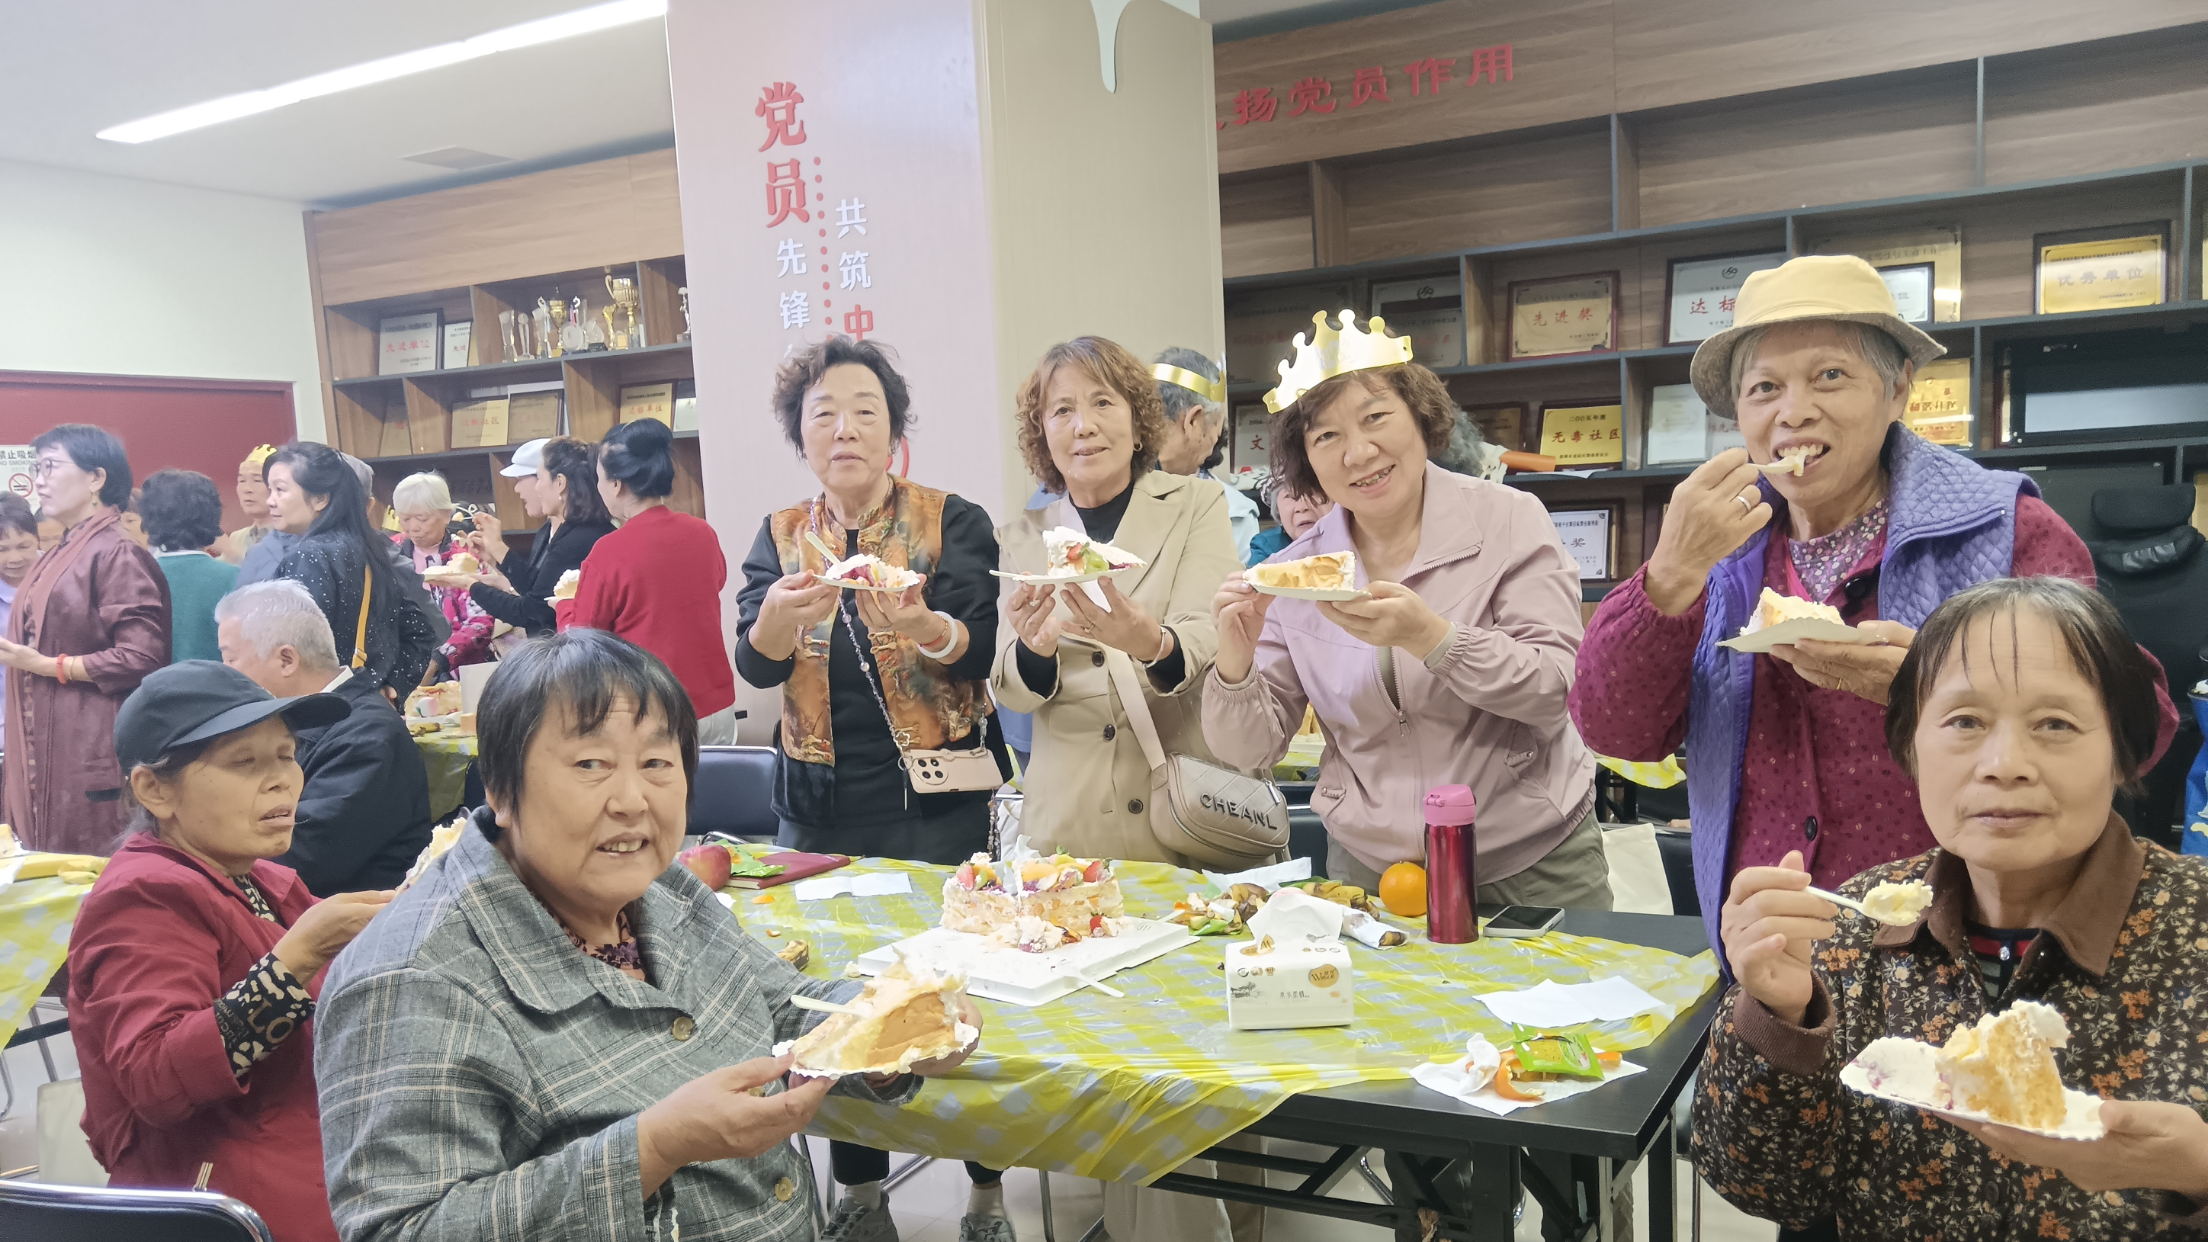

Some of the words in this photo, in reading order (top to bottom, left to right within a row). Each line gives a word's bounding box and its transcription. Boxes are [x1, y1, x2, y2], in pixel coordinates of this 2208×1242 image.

[1216, 44, 1513, 130] 扬党员作用
[2057, 267, 2143, 287] 优秀单位
[1690, 295, 1736, 315] 达标
[1533, 307, 1593, 327] 先进奖
[1249, 434, 1265, 450] 文
[1551, 427, 1620, 443] 无毒社区
[1200, 793, 1278, 830] CHEANL
